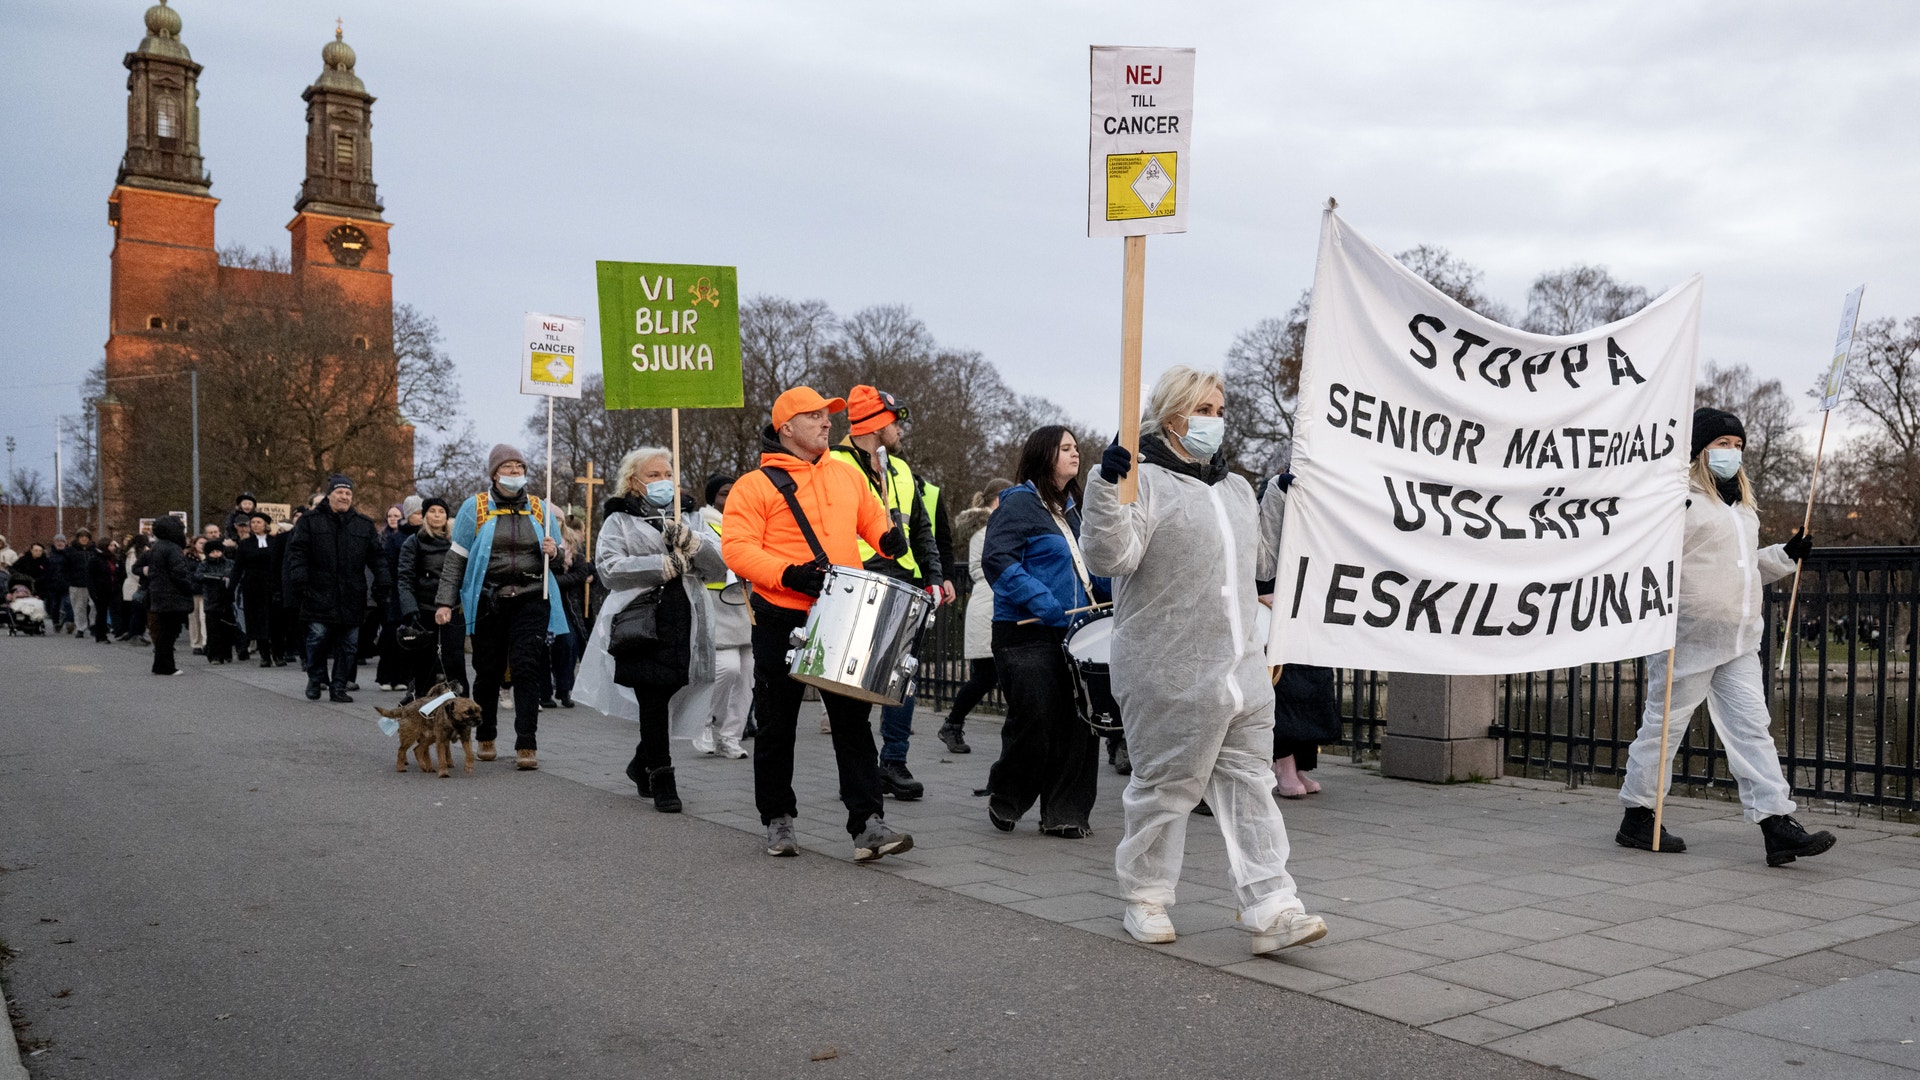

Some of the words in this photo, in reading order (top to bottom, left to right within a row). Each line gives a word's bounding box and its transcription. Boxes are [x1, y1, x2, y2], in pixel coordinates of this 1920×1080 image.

[1126, 65, 1163, 85] NEJ
[1131, 95, 1156, 107] TILL
[1104, 115, 1180, 135] CANCER
[639, 275, 674, 301] VI
[543, 322, 565, 332] NEJ
[636, 307, 698, 335] BLIR
[530, 342, 575, 354] CANCER
[632, 343, 714, 372] SJUKA
[1408, 313, 1647, 393] STOPPA
[1326, 383, 1486, 465] SENIOR
[1503, 418, 1677, 469] MATERIALS
[1383, 475, 1621, 540] UTSLÄPP
[1290, 556, 1310, 619] I
[1323, 560, 1675, 637] ESKILSTUNA!
